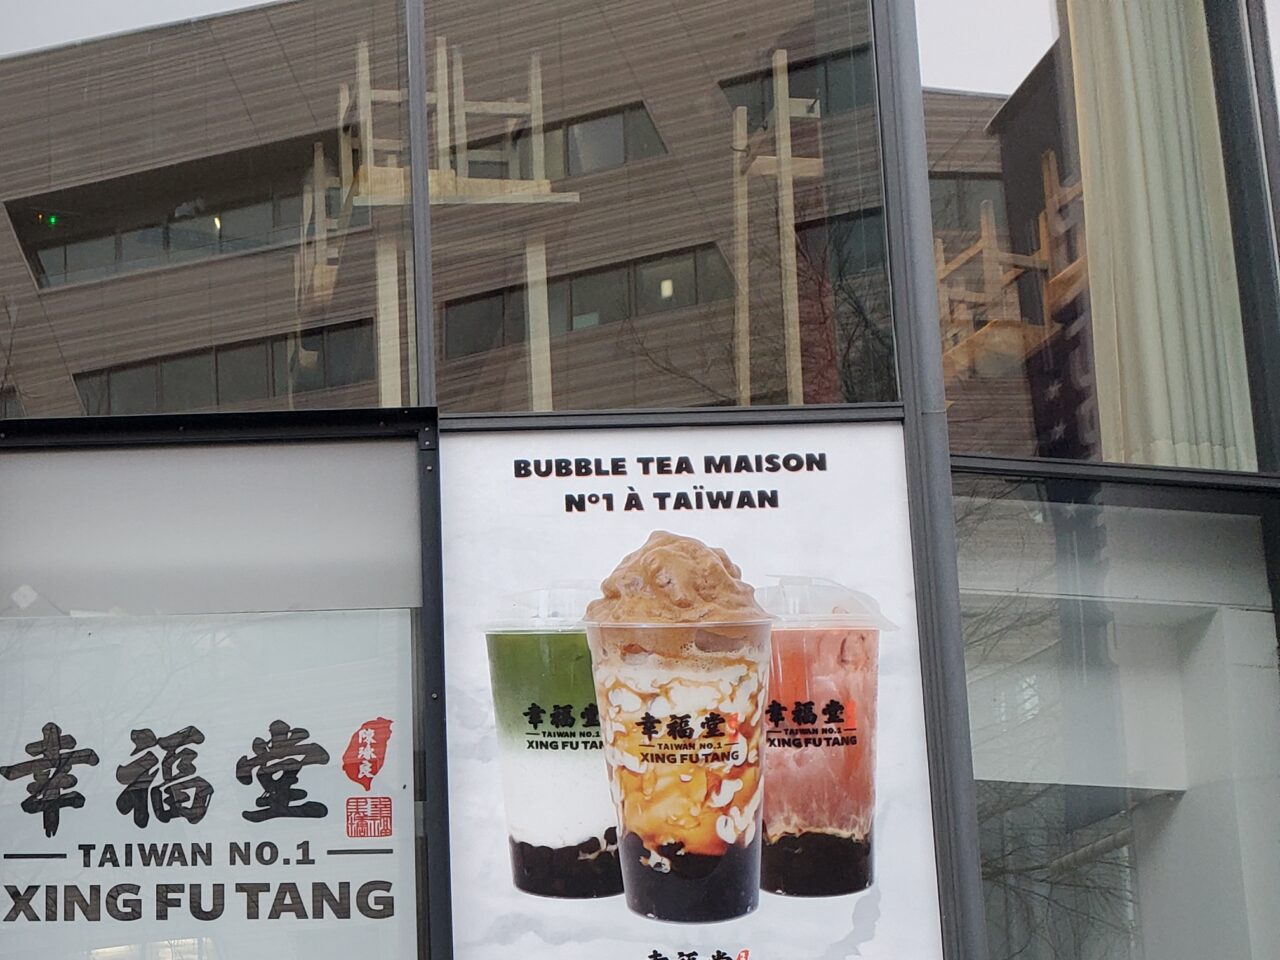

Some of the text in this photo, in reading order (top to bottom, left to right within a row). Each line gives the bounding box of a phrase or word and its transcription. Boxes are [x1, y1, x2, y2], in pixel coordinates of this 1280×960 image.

[513, 452, 828, 478] BUBBLE TEA MAISON
[623, 486, 645, 511] À
[652, 485, 779, 511] TAÏWAN
[635, 712, 726, 741] 幸福堂
[765, 699, 845, 728] 幸福堂
[527, 740, 605, 750] XING FU TAN
[767, 736, 857, 749] XING FU TANG
[783, 728, 819, 736] TAIWAN
[640, 751, 739, 764] XING FU TANG
[699, 742, 722, 750] NO.1
[78, 840, 316, 868] TAIWAN NO.1
[2, 879, 396, 922] XING FU TANG
